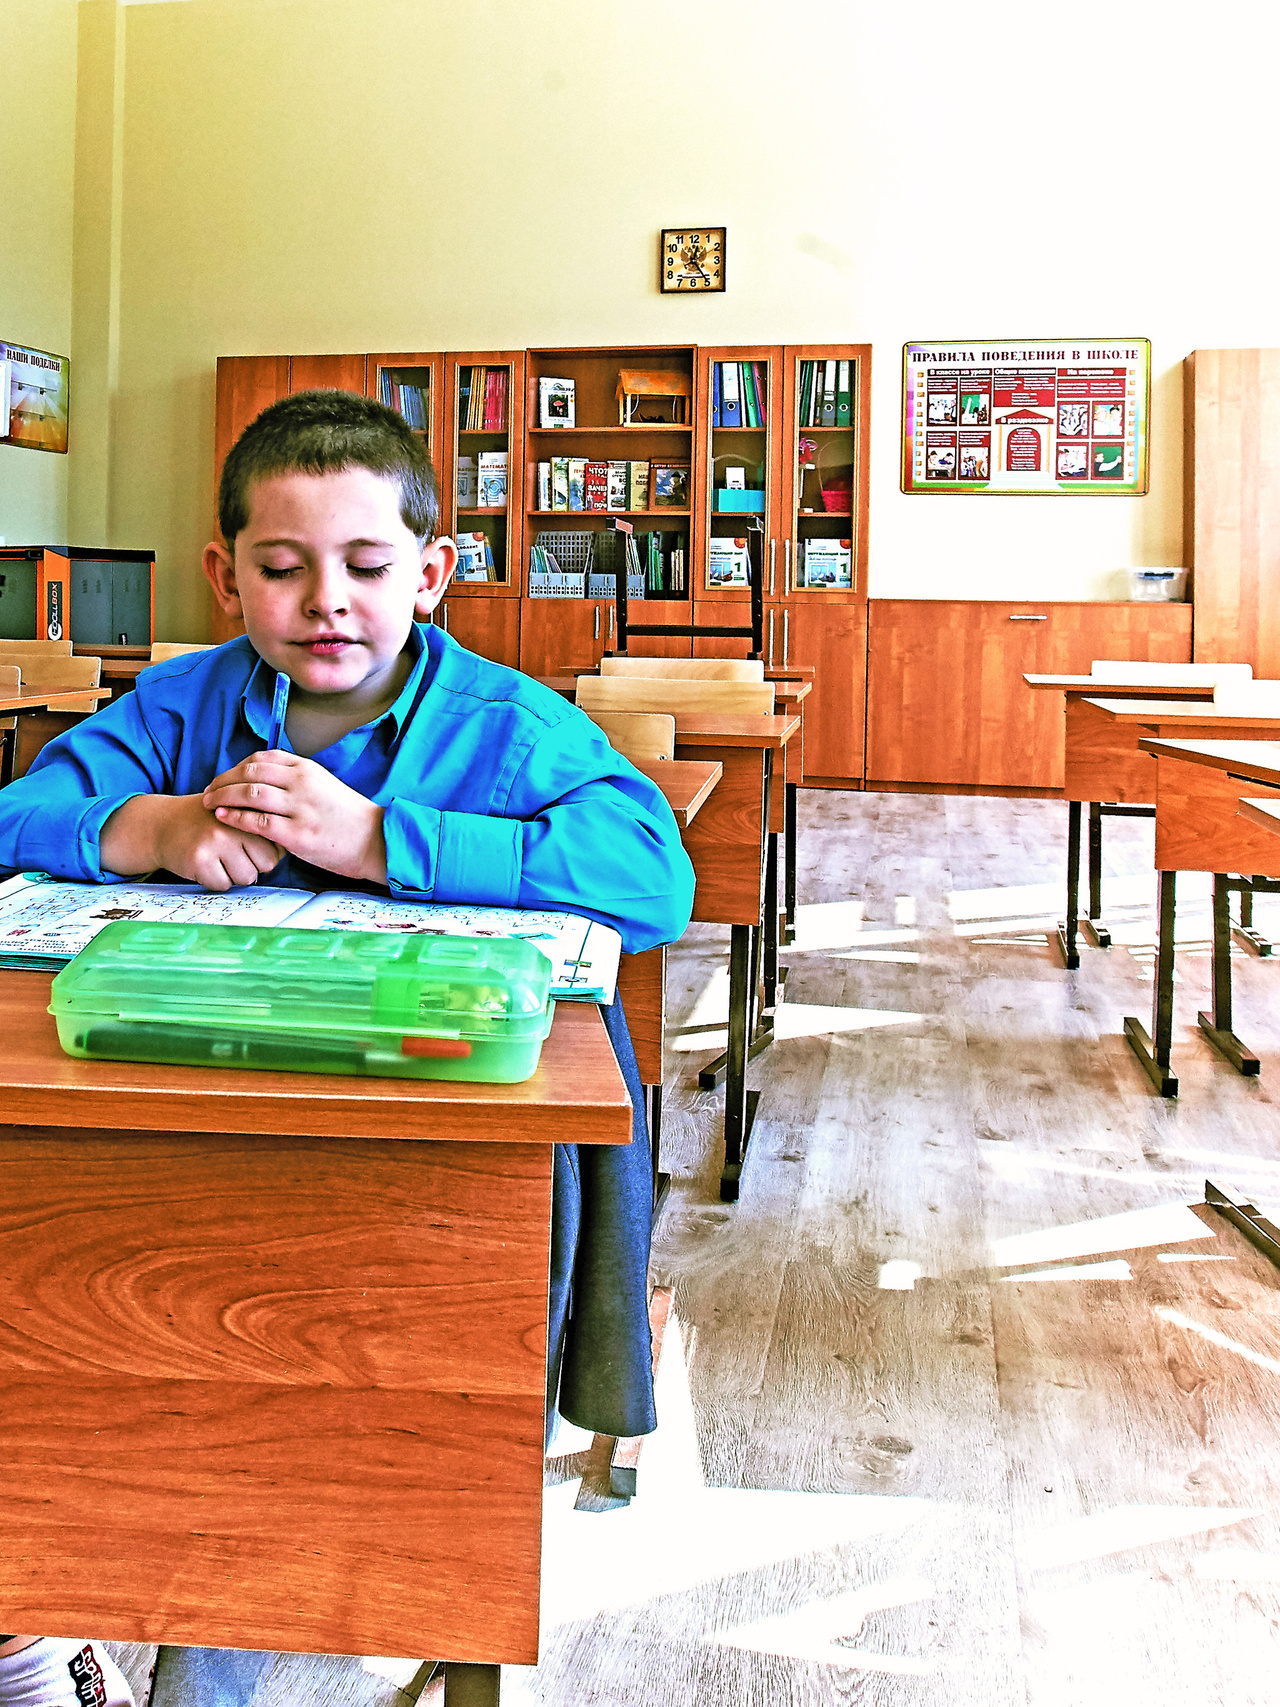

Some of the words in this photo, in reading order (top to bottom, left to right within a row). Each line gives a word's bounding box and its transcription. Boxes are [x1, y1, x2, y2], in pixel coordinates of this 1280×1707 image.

[676, 234, 684, 244] 11
[689, 234, 699, 243] 12
[705, 234, 710, 243] 1
[667, 244, 677, 253] 10
[714, 242, 720, 251] 2
[667, 257, 673, 266] 9
[714, 255, 720, 264] 3
[667, 270, 673, 279] 8
[713, 269, 720, 278] 4
[677, 278, 683, 287] 7
[690, 278, 696, 287] 6
[704, 278, 710, 286] 5
[6, 347, 29, 365] НАШИ
[29, 354, 62, 373] ПОДЕЛКИ
[912, 351, 976, 363] ПРАВИЛА
[981, 350, 1066, 362] ПОВЕДЕНИЯ
[1072, 350, 1081, 360] В
[1087, 349, 1139, 360] ШКОЛЕ
[474, 551, 482, 563] 1
[734, 562, 741, 573] 1
[840, 563, 847, 574] 1
